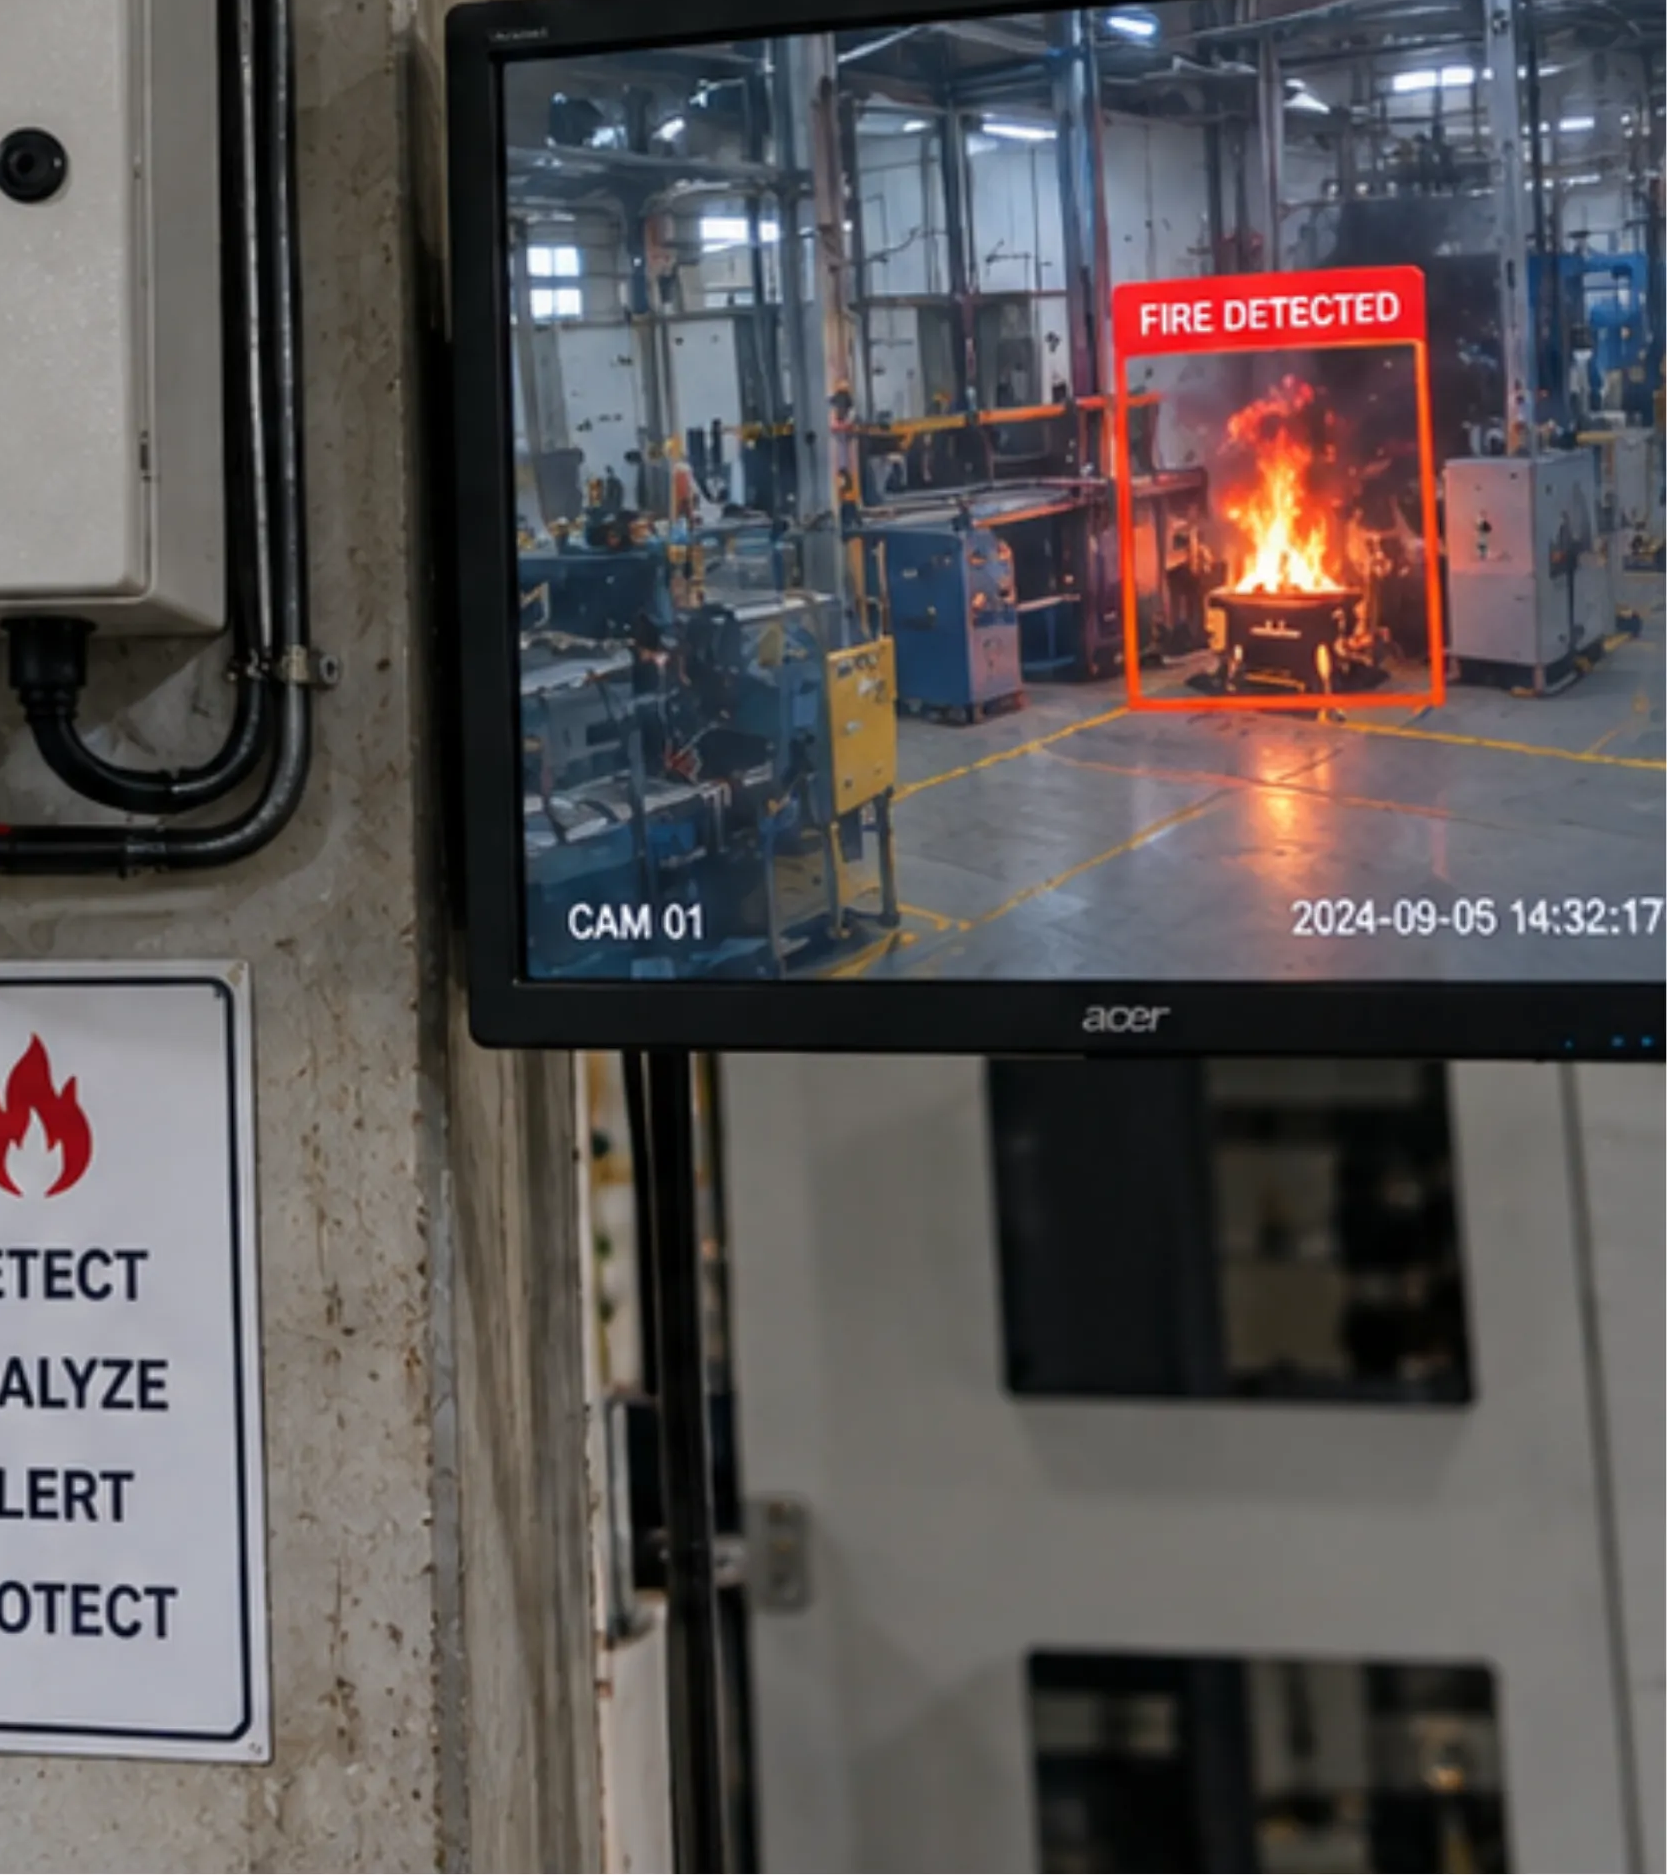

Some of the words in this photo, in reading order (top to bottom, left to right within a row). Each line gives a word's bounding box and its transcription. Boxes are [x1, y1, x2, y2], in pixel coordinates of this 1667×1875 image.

[1140, 301, 1213, 336] FIRE
[1224, 291, 1400, 332] DETECTED
[568, 903, 652, 940] CAM
[663, 903, 702, 940] 01
[1291, 898, 1497, 936] 2024-09-05
[1511, 898, 1665, 936] 14:32:17
[1081, 1006, 1171, 1033] acer
